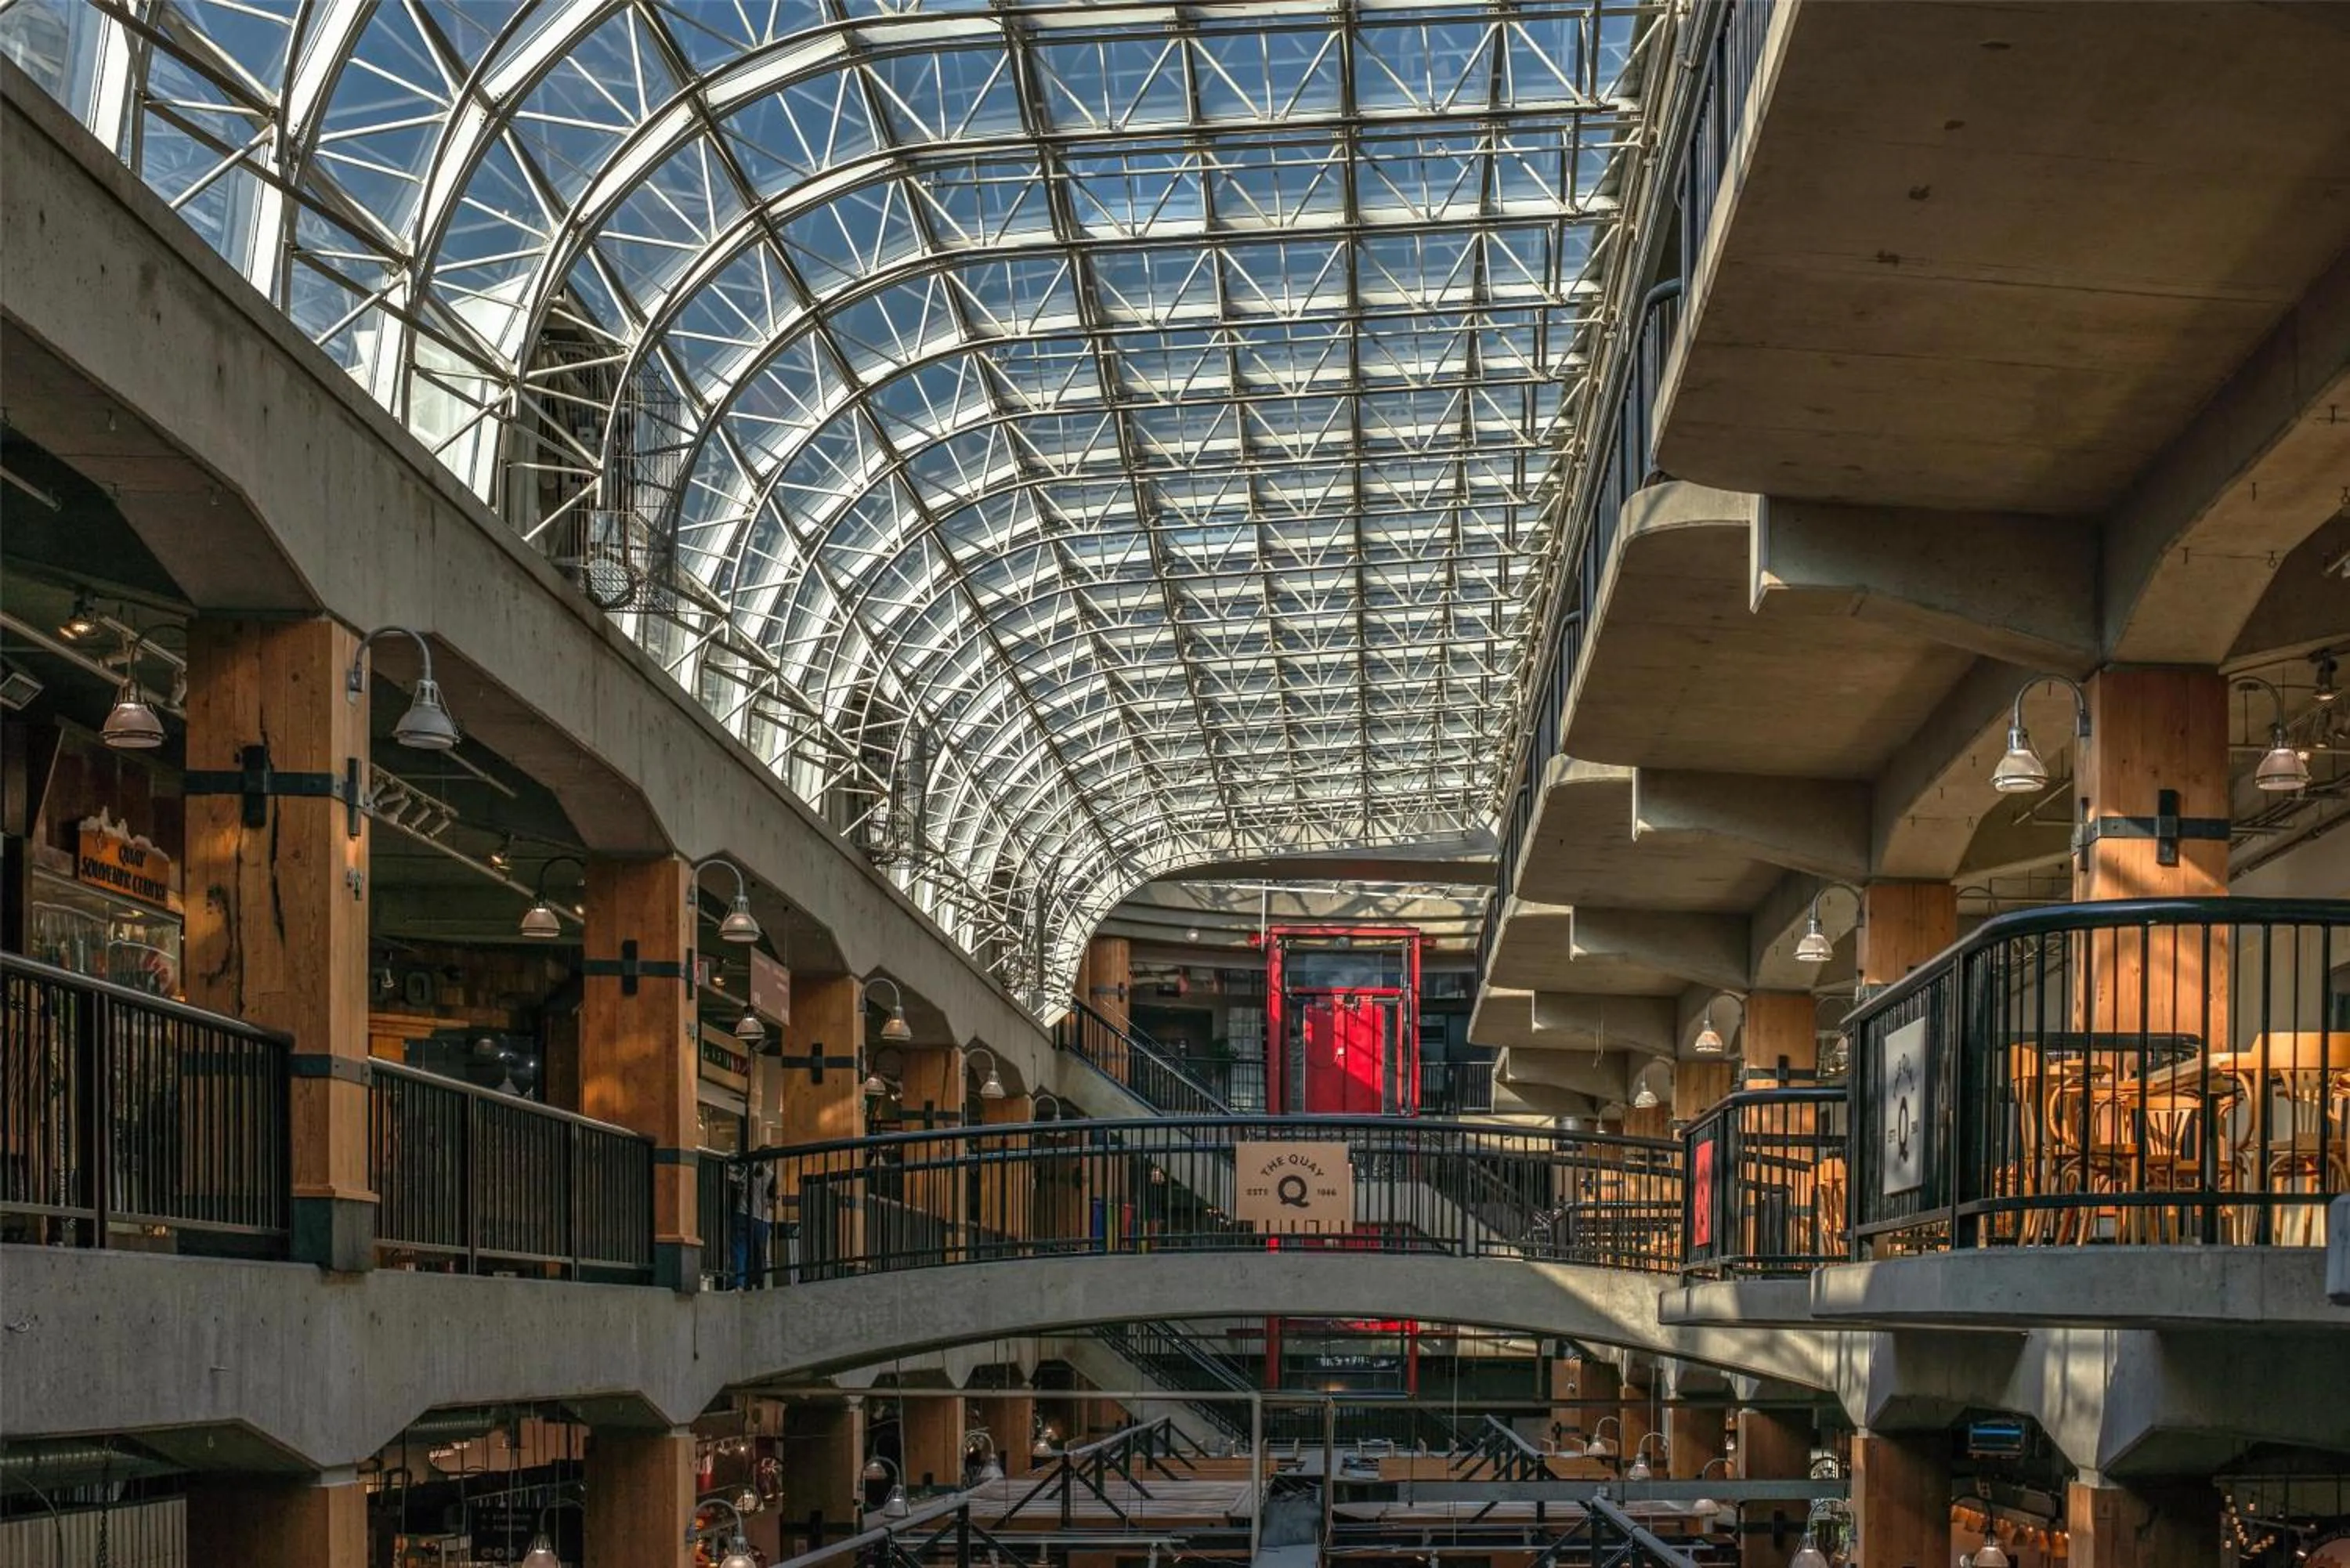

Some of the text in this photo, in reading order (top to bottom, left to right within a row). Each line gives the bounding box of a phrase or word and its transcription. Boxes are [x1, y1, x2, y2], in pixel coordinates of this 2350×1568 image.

[1260, 1154, 1325, 1177] THE QUAY
[1278, 1175, 1311, 1208] Q
